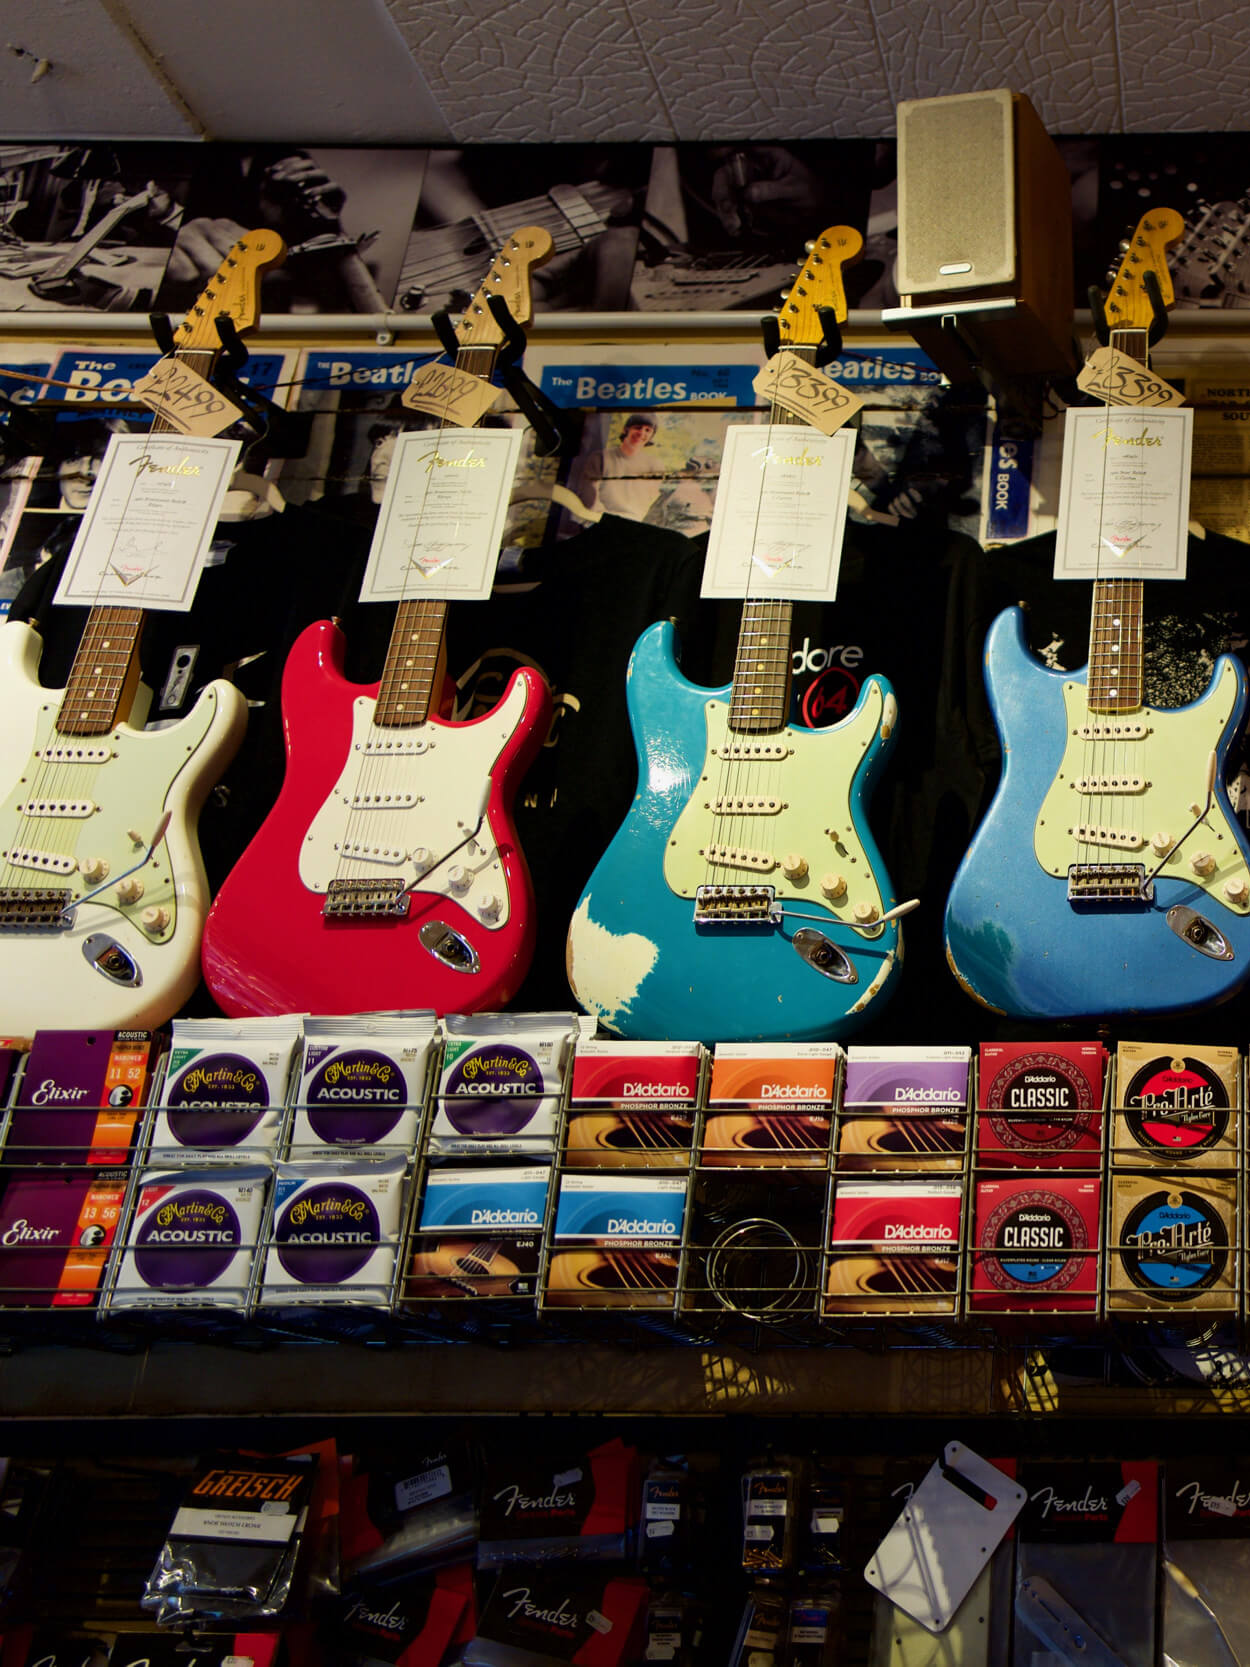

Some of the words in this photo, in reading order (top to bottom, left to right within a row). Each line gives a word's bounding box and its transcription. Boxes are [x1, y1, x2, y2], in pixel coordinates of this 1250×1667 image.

[74, 360, 117, 371] The
[329, 361, 420, 385] Beatl
[822, 357, 916, 380] eatles
[551, 376, 573, 386] The
[576, 376, 687, 400] Beatles
[690, 391, 728, 401] BOOK
[772, 359, 850, 412] £3399
[1085, 355, 1173, 406] £3399
[1092, 426, 1164, 450] Fender
[129, 455, 201, 479] Fender
[417, 449, 488, 473] Fender
[995, 473, 1010, 511] BOOK
[117, 1031, 148, 1039] ACOUSTIC
[109, 1068, 121, 1079] 11
[127, 1068, 141, 1079] 52
[1024, 1075, 1056, 1083] D'Addario
[32, 1079, 89, 1105] Elixir
[317, 1087, 400, 1100] ACOUSTIC
[455, 1082, 536, 1094] ACOUSTIC
[623, 1081, 690, 1097] D'Addario
[760, 1083, 828, 1098] D'Addario
[895, 1087, 961, 1102] D'Addario
[179, 1100, 261, 1113] ACOUSTIC
[1011, 1087, 1069, 1108] CLASSIC
[83, 1207, 97, 1219] 13
[102, 1207, 116, 1219] 56
[471, 1208, 538, 1224] D'Addario
[1018, 1213, 1051, 1222] D'Addario
[2, 1219, 60, 1246] Elixir
[608, 1218, 675, 1233] D'Addario
[884, 1223, 952, 1239] D'Addario
[146, 1230, 233, 1242] ACOUSTIC
[287, 1231, 371, 1243] ACOUSTIC
[1004, 1226, 1064, 1248] CLASSIC
[192, 1469, 305, 1501] GRETSCH
[492, 1484, 576, 1517] Fender
[1030, 1484, 1109, 1519] Fender
[502, 1587, 577, 1628] Fender
